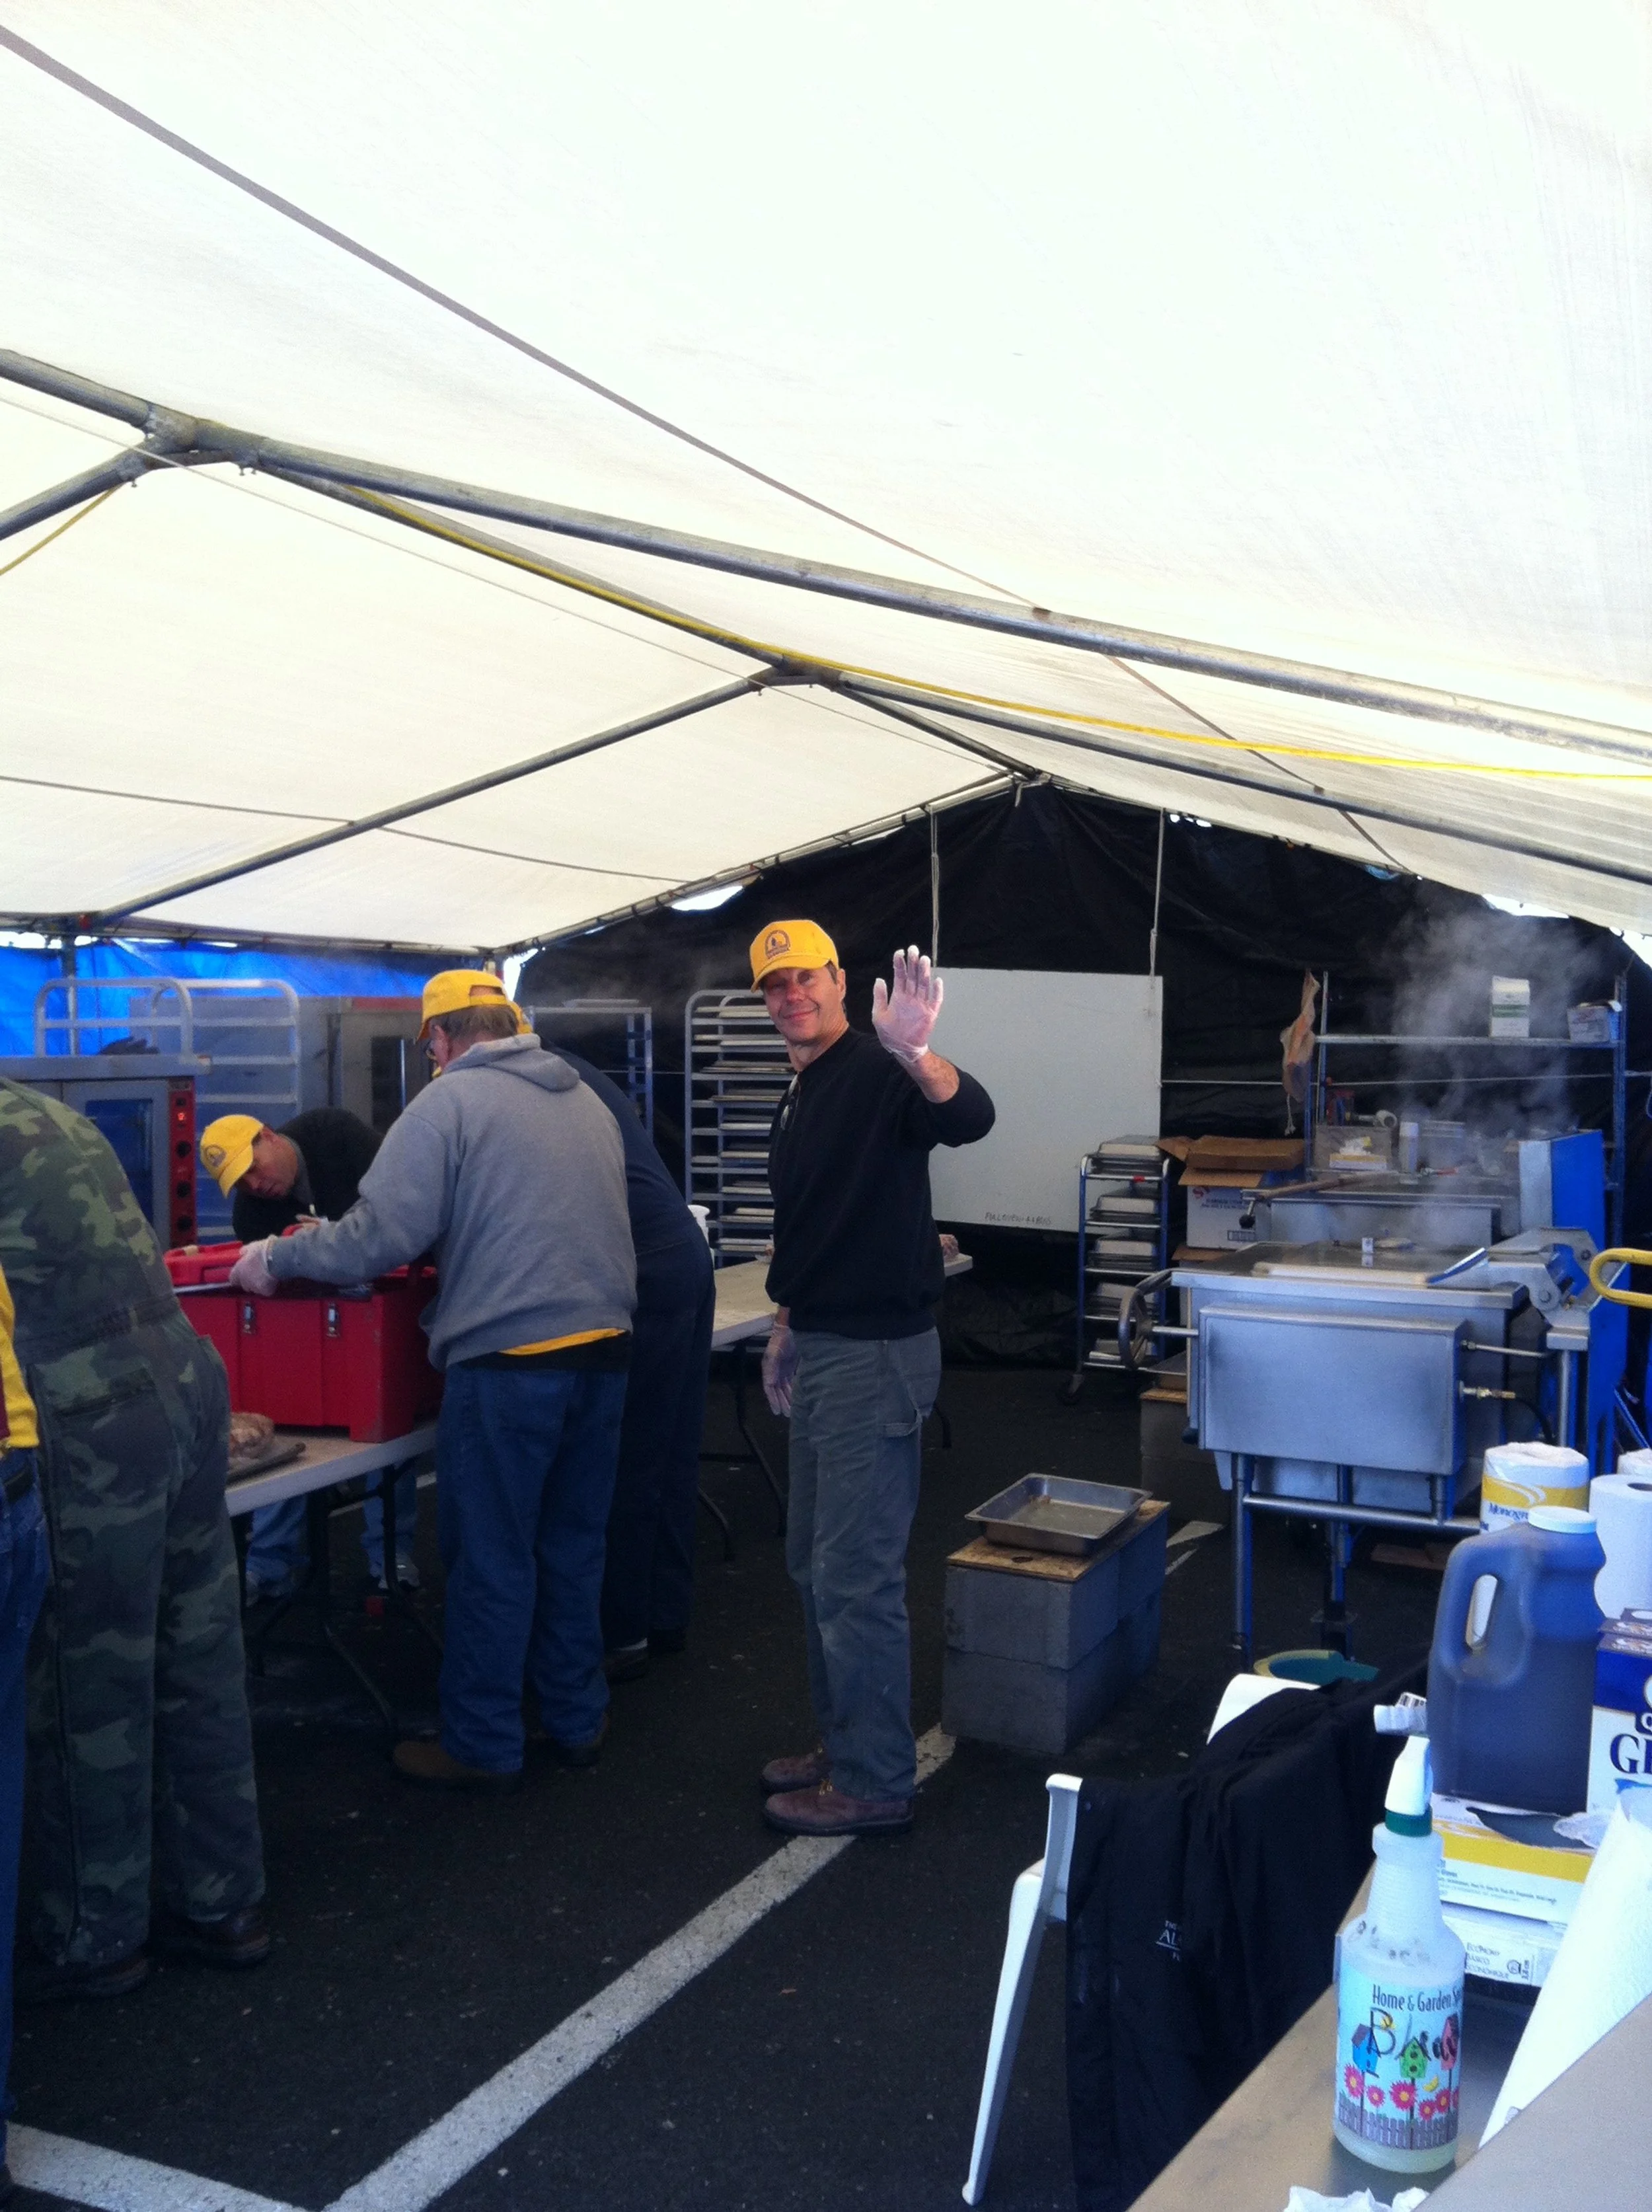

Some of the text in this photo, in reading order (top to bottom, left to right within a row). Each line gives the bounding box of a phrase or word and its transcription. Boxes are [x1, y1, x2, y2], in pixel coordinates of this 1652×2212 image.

[1372, 1983, 1405, 2012] Home
[1407, 1995, 1415, 2012] &
[1417, 1990, 1452, 2012] Garden
